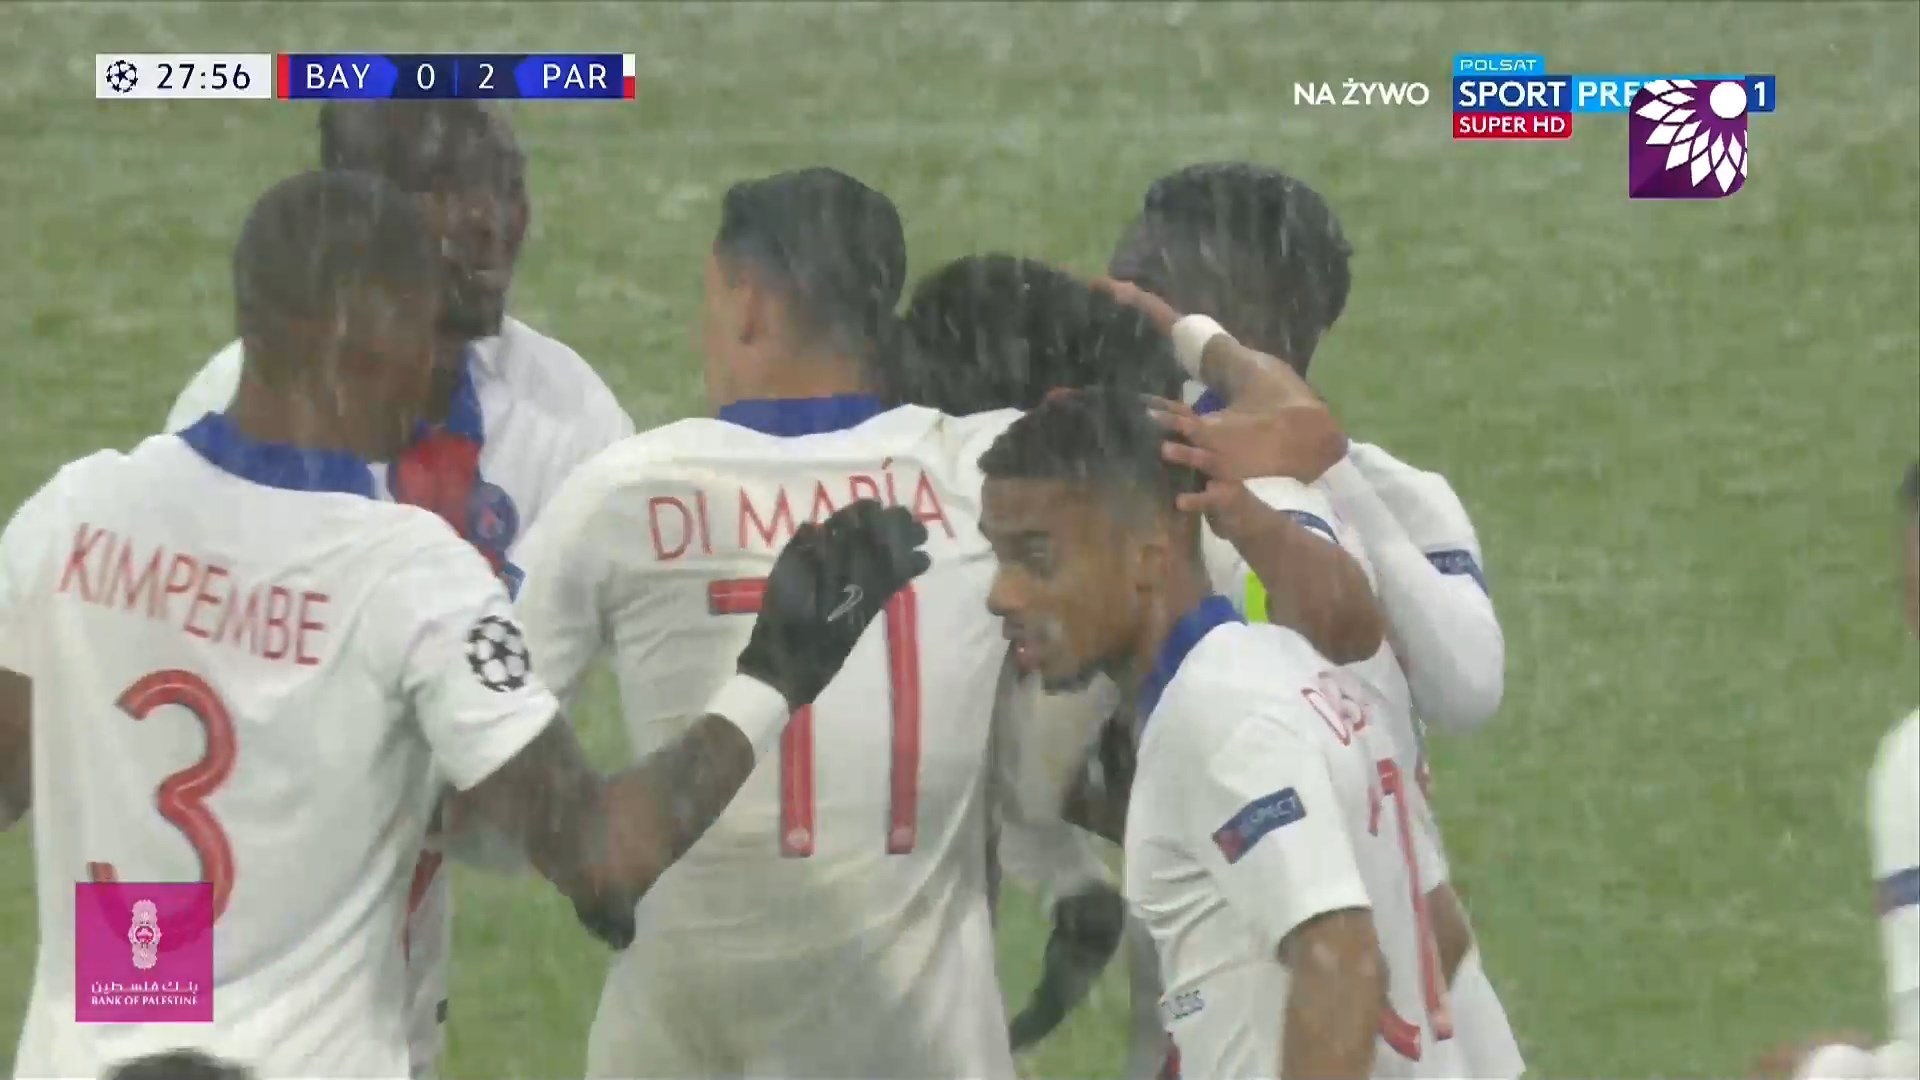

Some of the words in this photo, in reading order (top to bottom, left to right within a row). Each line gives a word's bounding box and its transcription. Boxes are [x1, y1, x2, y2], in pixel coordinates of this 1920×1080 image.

[58, 522, 331, 666] KIMPEMBE
[648, 489, 713, 561] DI
[87, 668, 238, 952] 3
